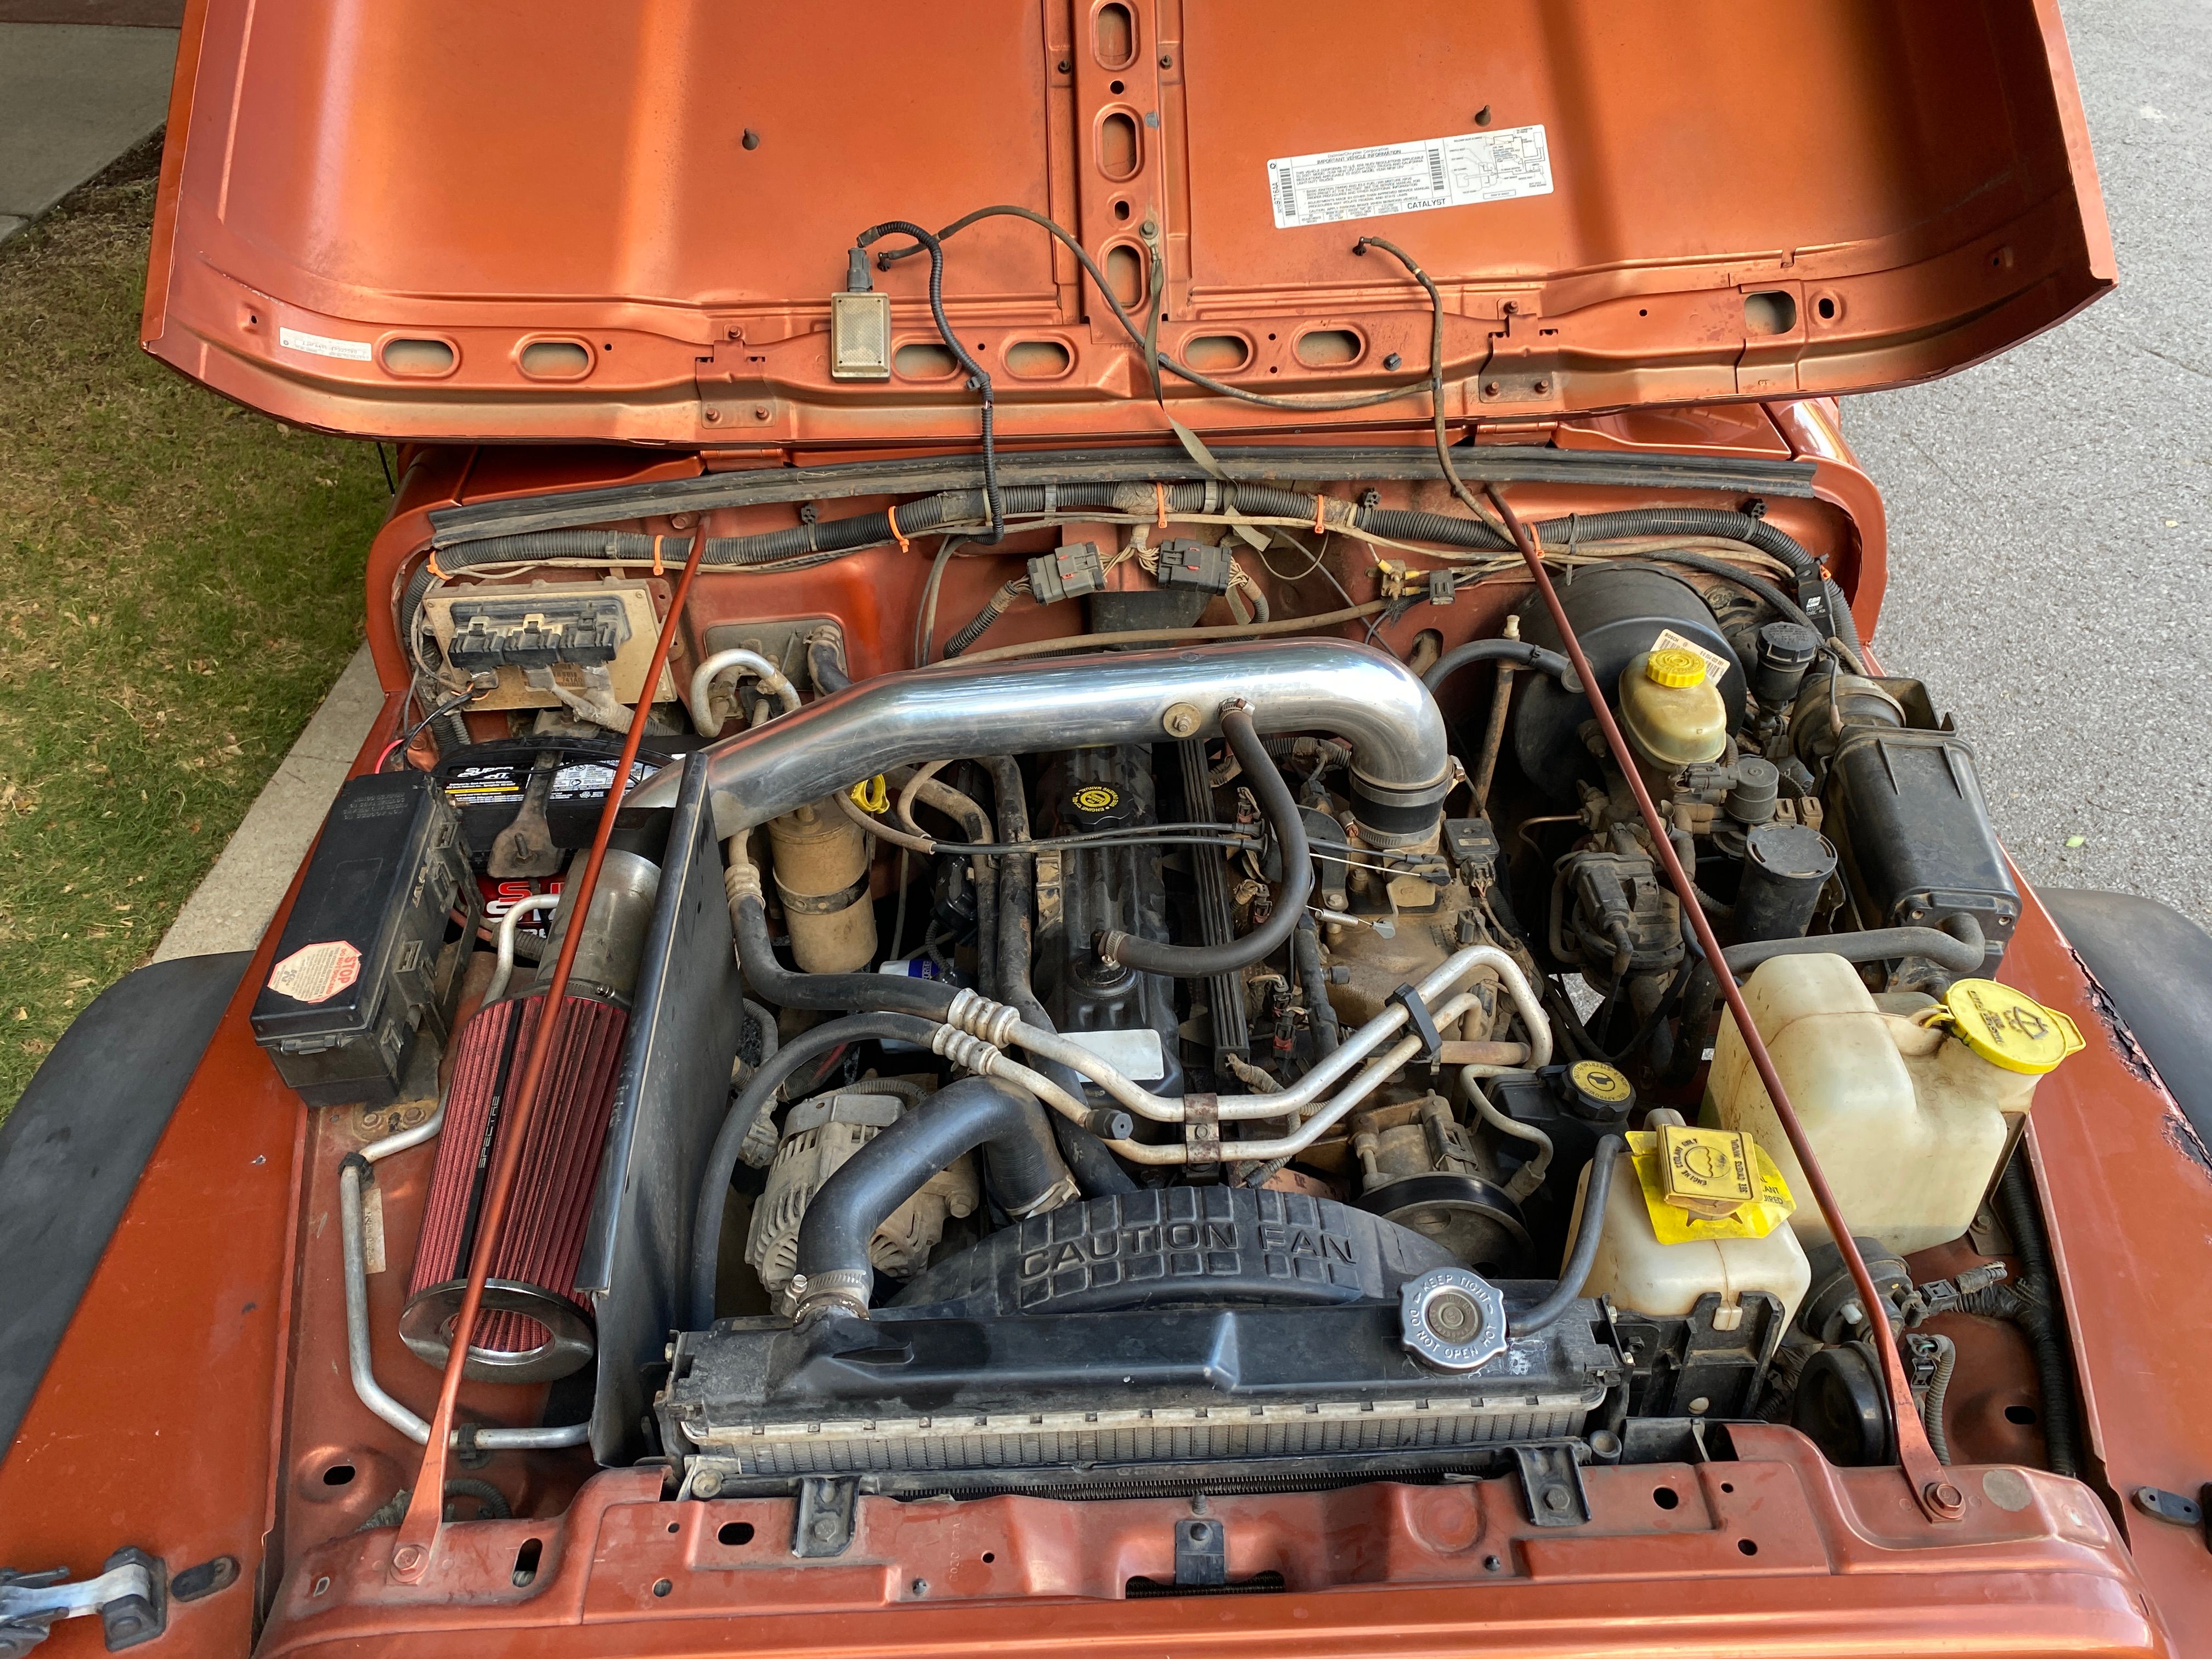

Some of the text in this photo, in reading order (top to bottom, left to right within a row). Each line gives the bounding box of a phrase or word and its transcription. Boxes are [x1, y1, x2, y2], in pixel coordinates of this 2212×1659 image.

[1327, 150, 1362, 158] DaimlerChrysler
[1367, 149, 1401, 157] INFORMATION
[1407, 198, 1446, 209] CATALYST
[1664, 633, 1679, 642] BOSCH
[325, 948, 347, 995] DO NOT DISCARD
[338, 956, 357, 984] STOP
[1584, 1087, 1616, 1101] APPROVED
[478, 1096, 500, 1169] SPECTRE
[1673, 1137, 1707, 1187] ENGINE COOLANT ONLY
[1020, 1221, 1357, 1280] CAUTION FAN
[1421, 1274, 1491, 1303] KEEP TIGHT
[1409, 1309, 1421, 1327] DO
[1416, 1330, 1441, 1352] NOT
[1444, 1345, 1479, 1359] OPEN
[1482, 1323, 1497, 1347] HOT
